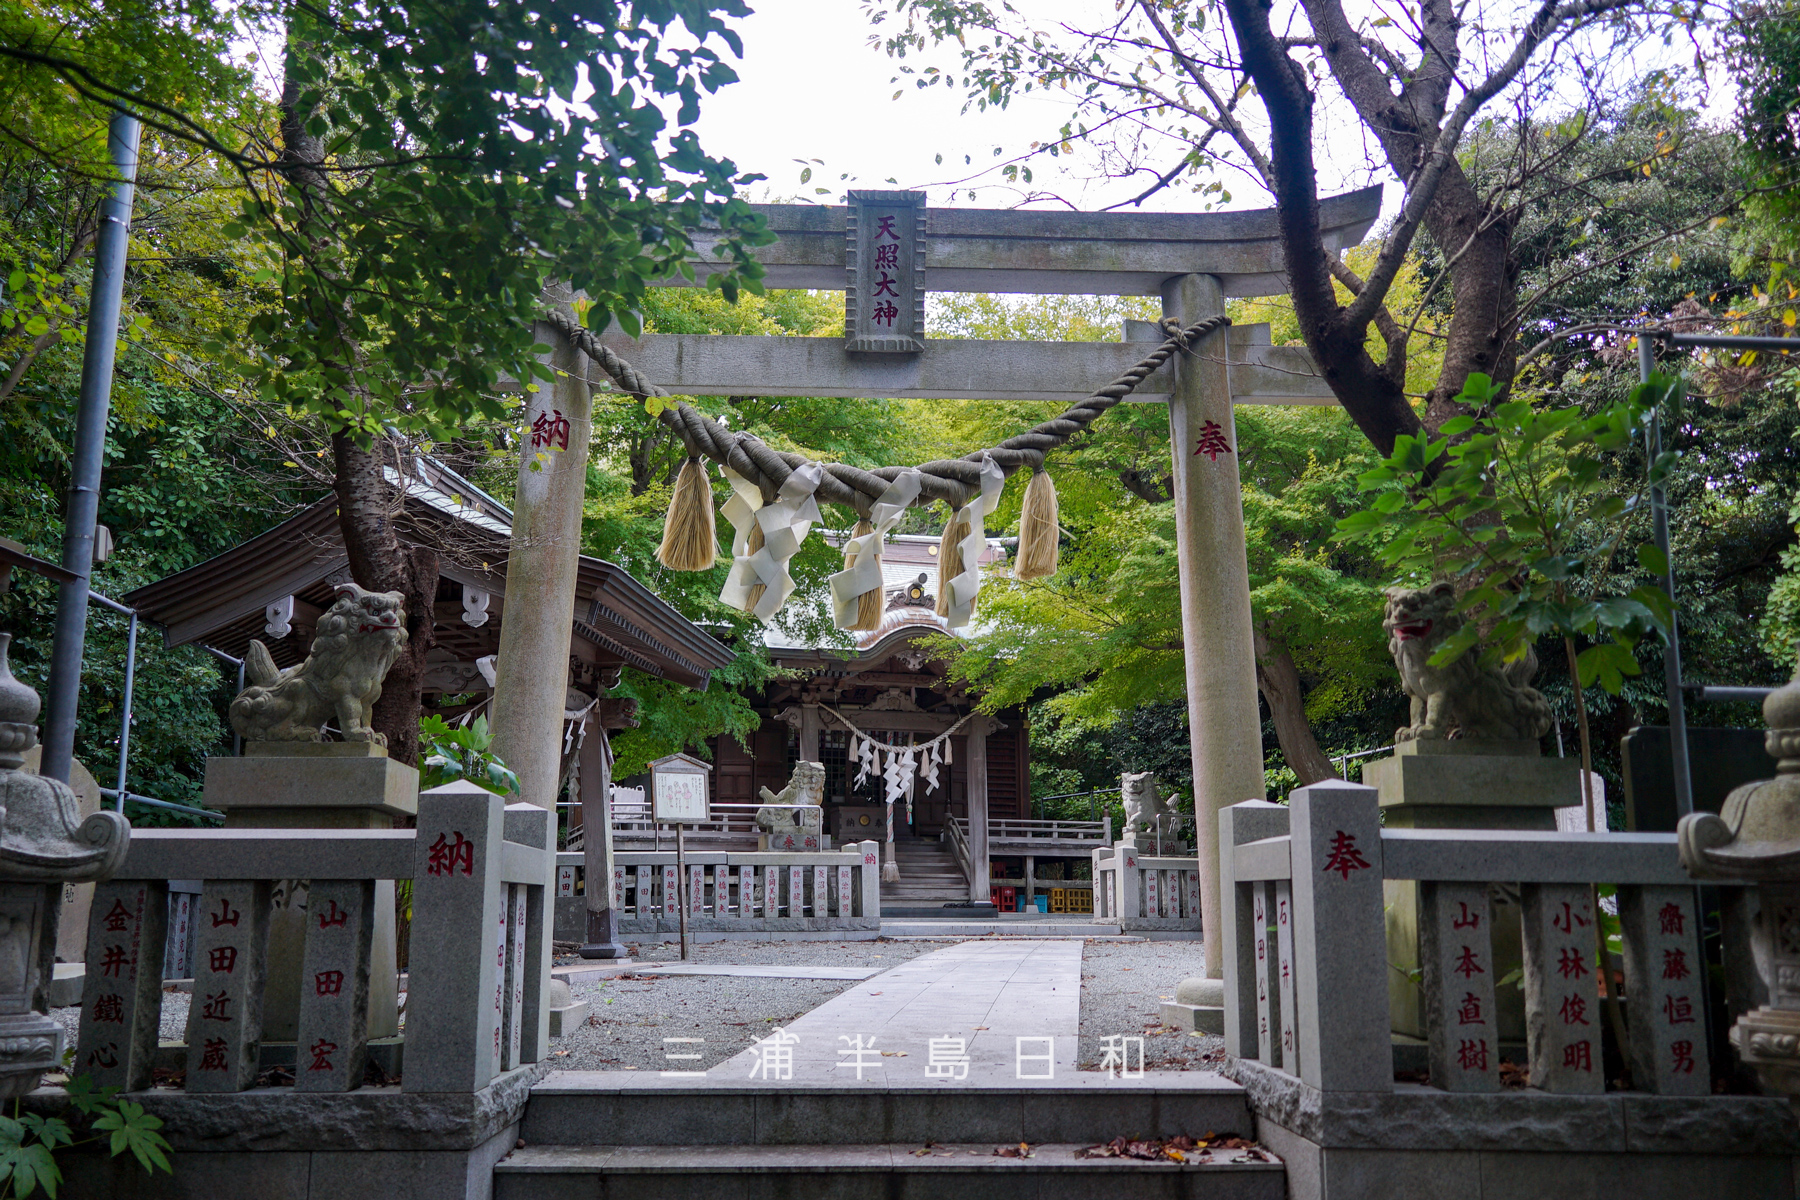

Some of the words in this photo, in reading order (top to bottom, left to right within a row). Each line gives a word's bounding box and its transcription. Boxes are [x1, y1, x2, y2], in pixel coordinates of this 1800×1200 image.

[871, 215, 901, 328] 天照大神
[531, 409, 570, 451] 納
[1193, 420, 1232, 462] 奉
[428, 832, 474, 878] 納
[783, 834, 817, 849] 奉納
[864, 853, 876, 865] 納
[1125, 856, 1136, 868] 奉
[1146, 840, 1176, 853] 奉納
[1323, 830, 1371, 881] 奉
[562, 871, 571, 897] 山田
[308, 899, 348, 1073] 山田宏
[1256, 897, 1269, 1041] 山田公平
[1279, 900, 1293, 1053] 石井功
[1453, 901, 1490, 1073] 山本直樹
[1553, 901, 1593, 1073] 小林俊明
